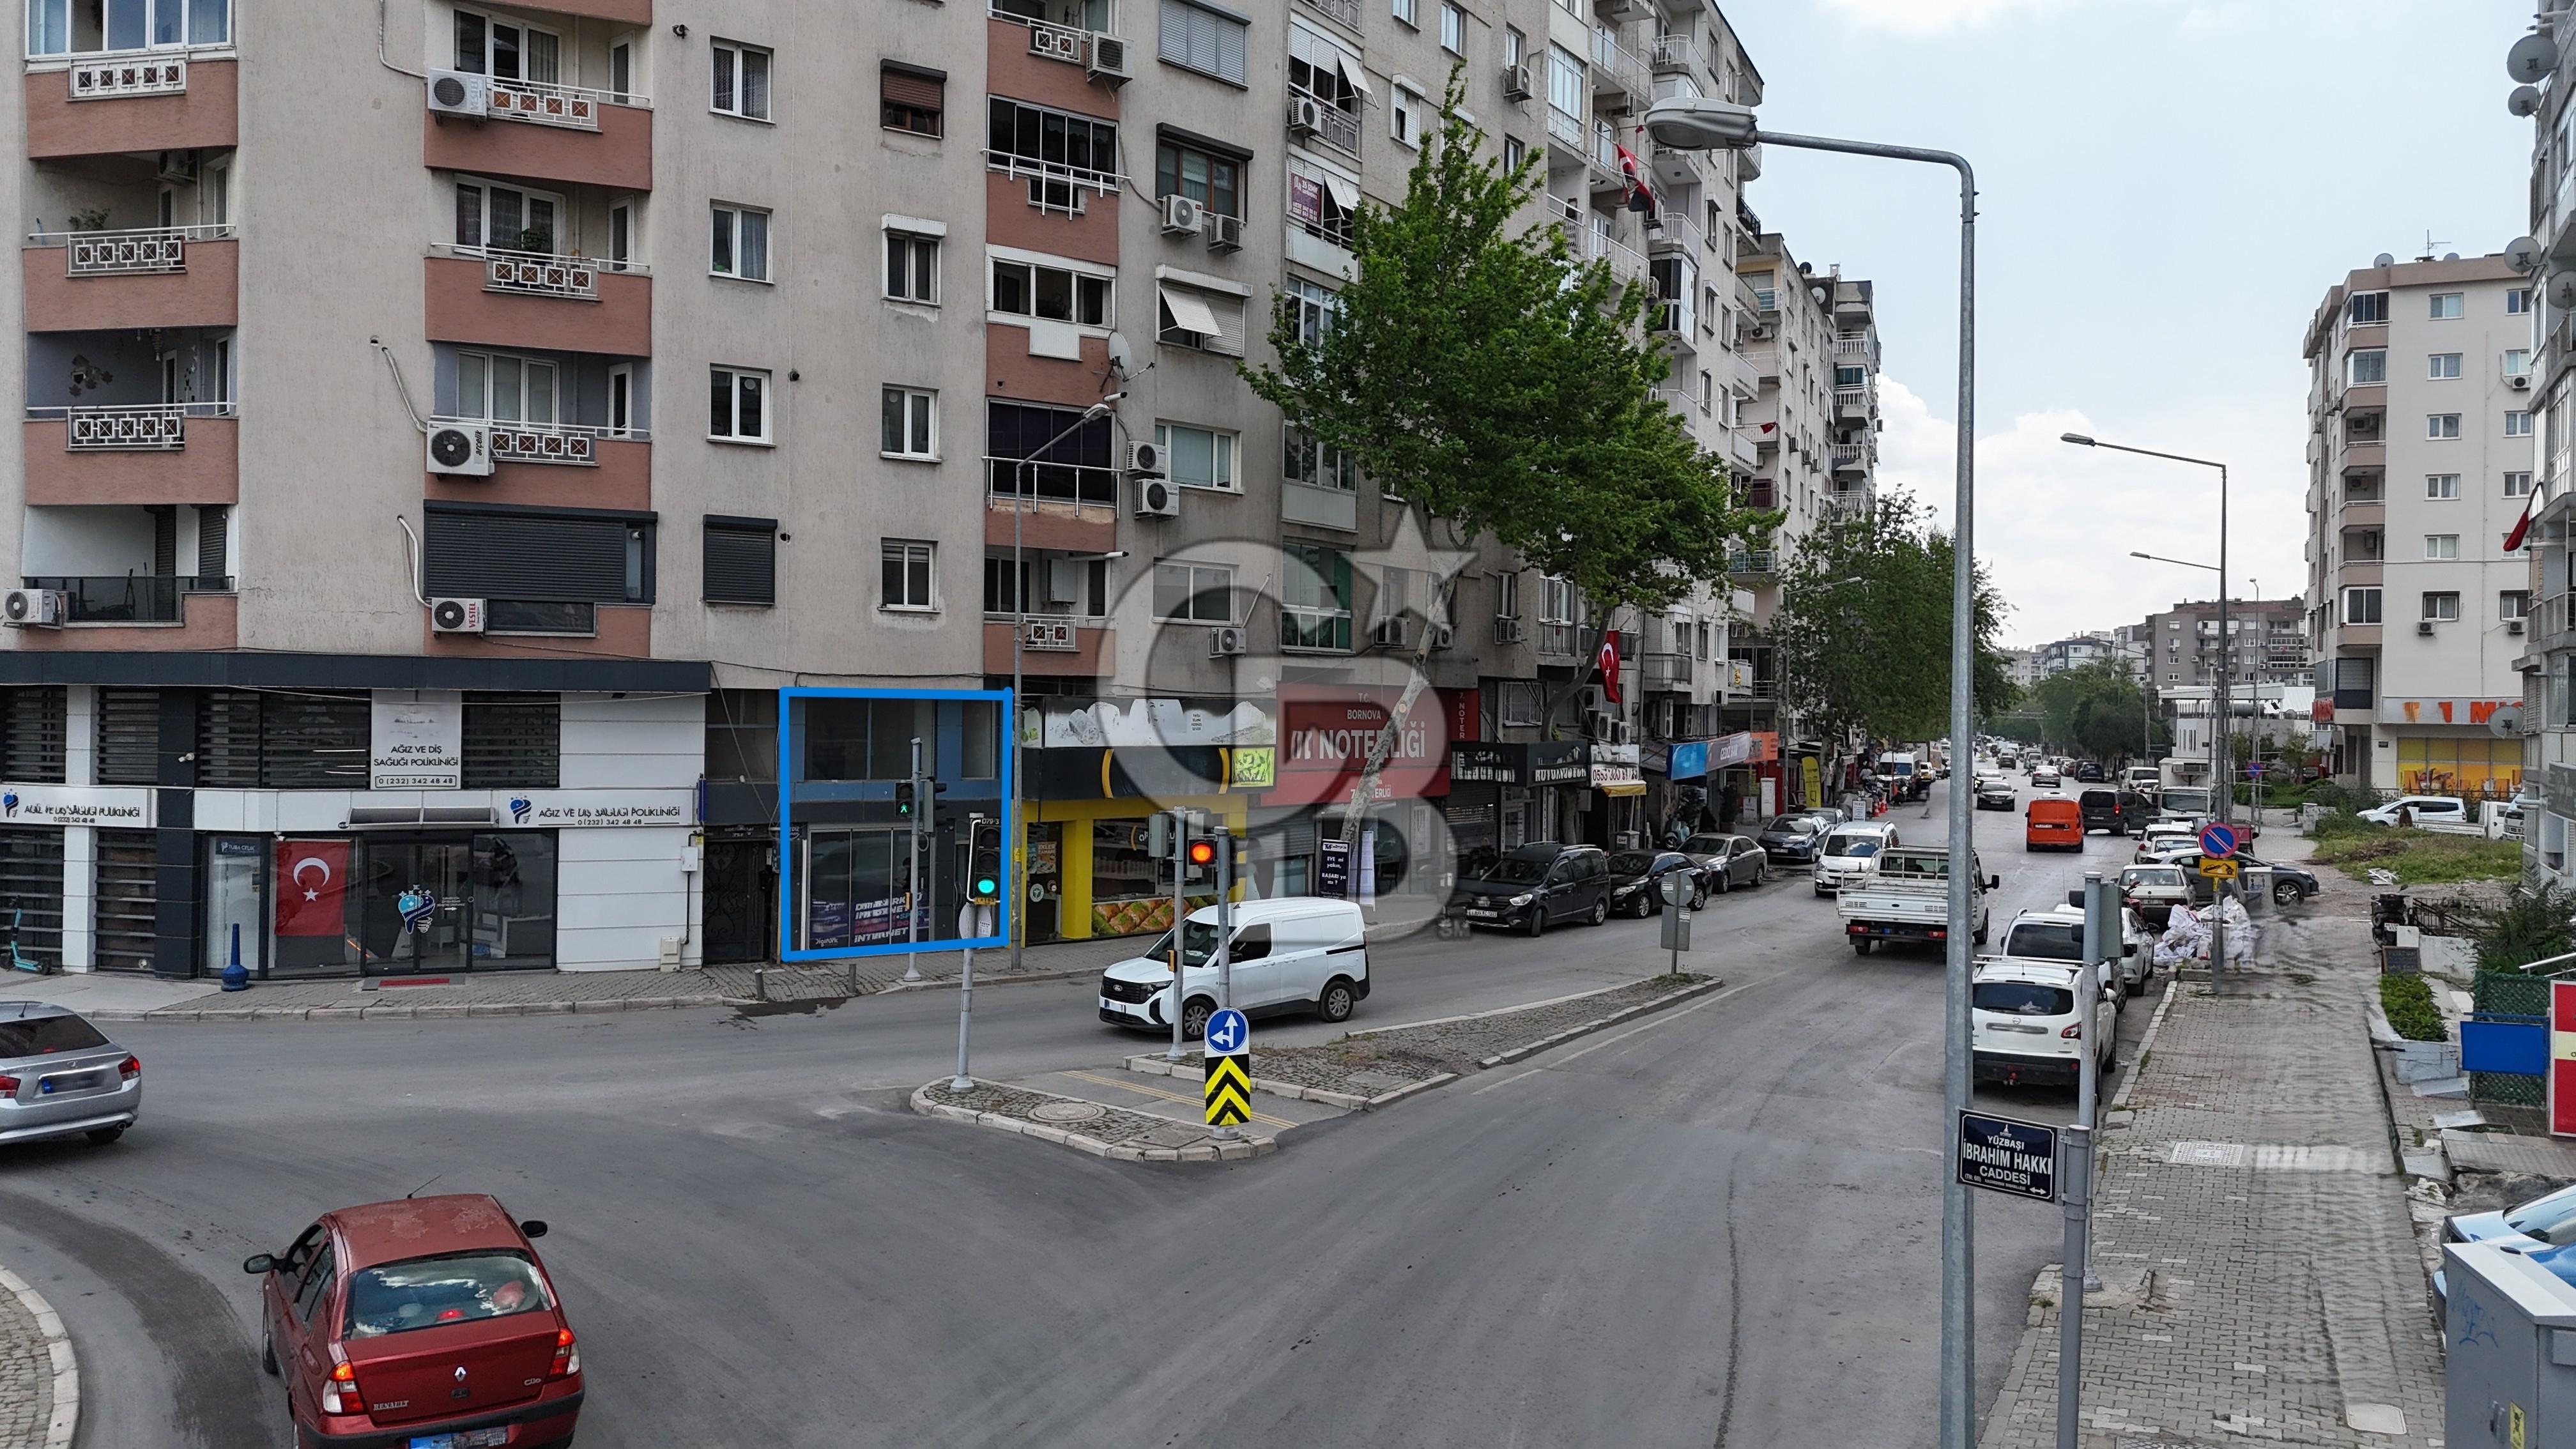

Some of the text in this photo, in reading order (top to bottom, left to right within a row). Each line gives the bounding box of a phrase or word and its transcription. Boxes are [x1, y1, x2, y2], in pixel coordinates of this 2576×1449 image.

[1358, 693, 1370, 703] T.C.
[1347, 709, 1381, 720] BORNOVA
[1319, 721, 1425, 760] NOTELİĞİ
[391, 744, 413, 753] AĞIZ
[429, 744, 441, 754] DİŞ
[374, 757, 458, 766] SAĞLIĞI POLİKLİNİĞİ
[539, 808, 560, 817] AĞIZ
[564, 808, 574, 817] VE
[631, 806, 680, 816] POLİKLİNİĞİ
[1987, 1135, 2025, 1151] YÜZBAŞI
[1963, 1138, 2051, 1174] İBRAHİM HAKKI
[1980, 1165, 2030, 1185] CADDESİ
[374, 1400, 409, 1411] RENAULT
